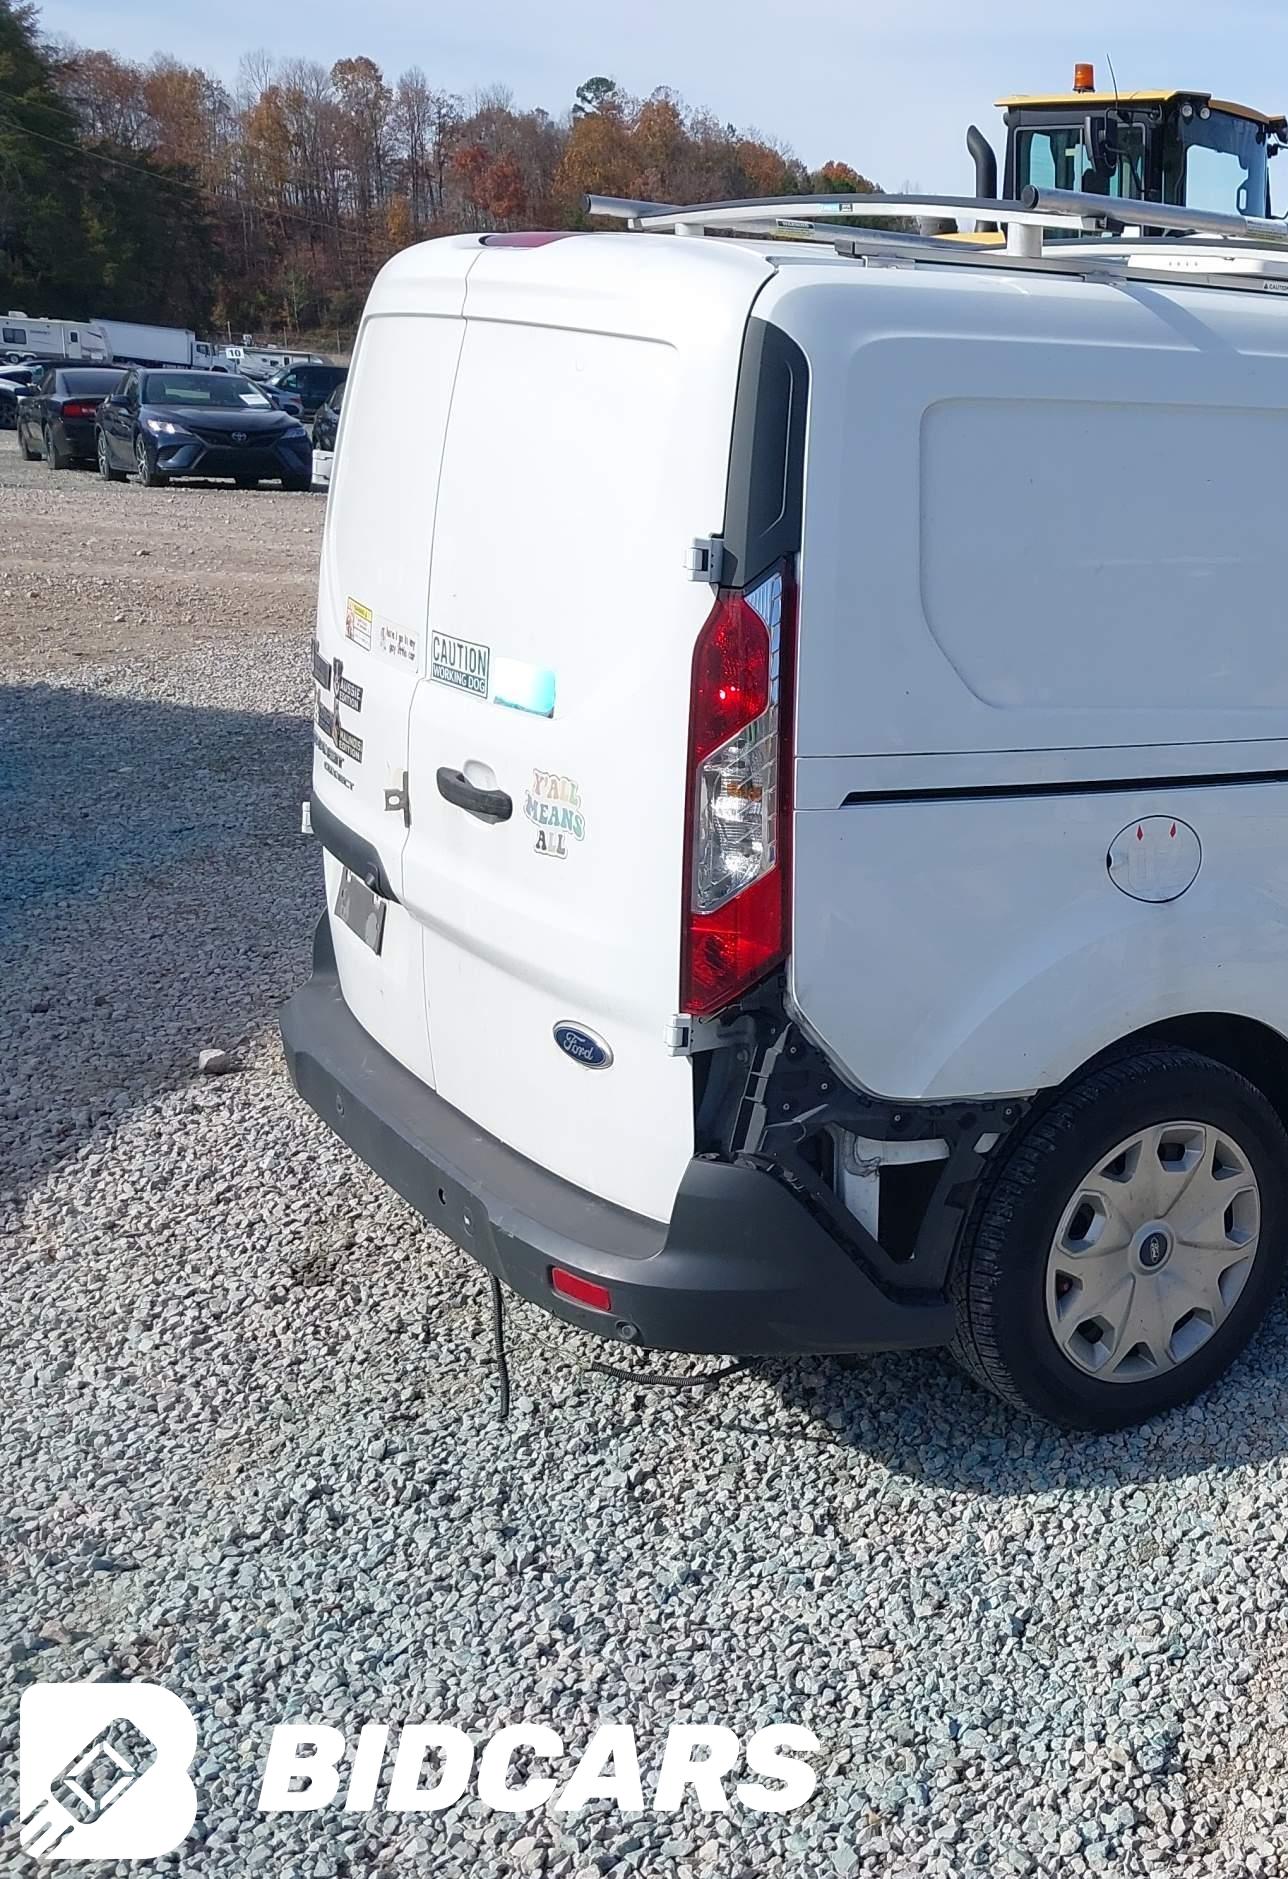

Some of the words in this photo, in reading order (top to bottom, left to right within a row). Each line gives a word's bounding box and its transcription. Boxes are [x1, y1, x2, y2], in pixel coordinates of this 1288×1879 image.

[230, 349, 241, 357] 10
[433, 636, 487, 677] CAUTION
[339, 677, 361, 700] AUSSIE
[433, 664, 467, 686] WORKING
[468, 675, 486, 692] DOG
[339, 689, 360, 710] EDITION
[339, 740, 360, 761] EDITION
[533, 773, 578, 806] Y'ALL
[526, 793, 583, 838] MEANS
[536, 830, 566, 855] ALL
[563, 1031, 594, 1060] Ford
